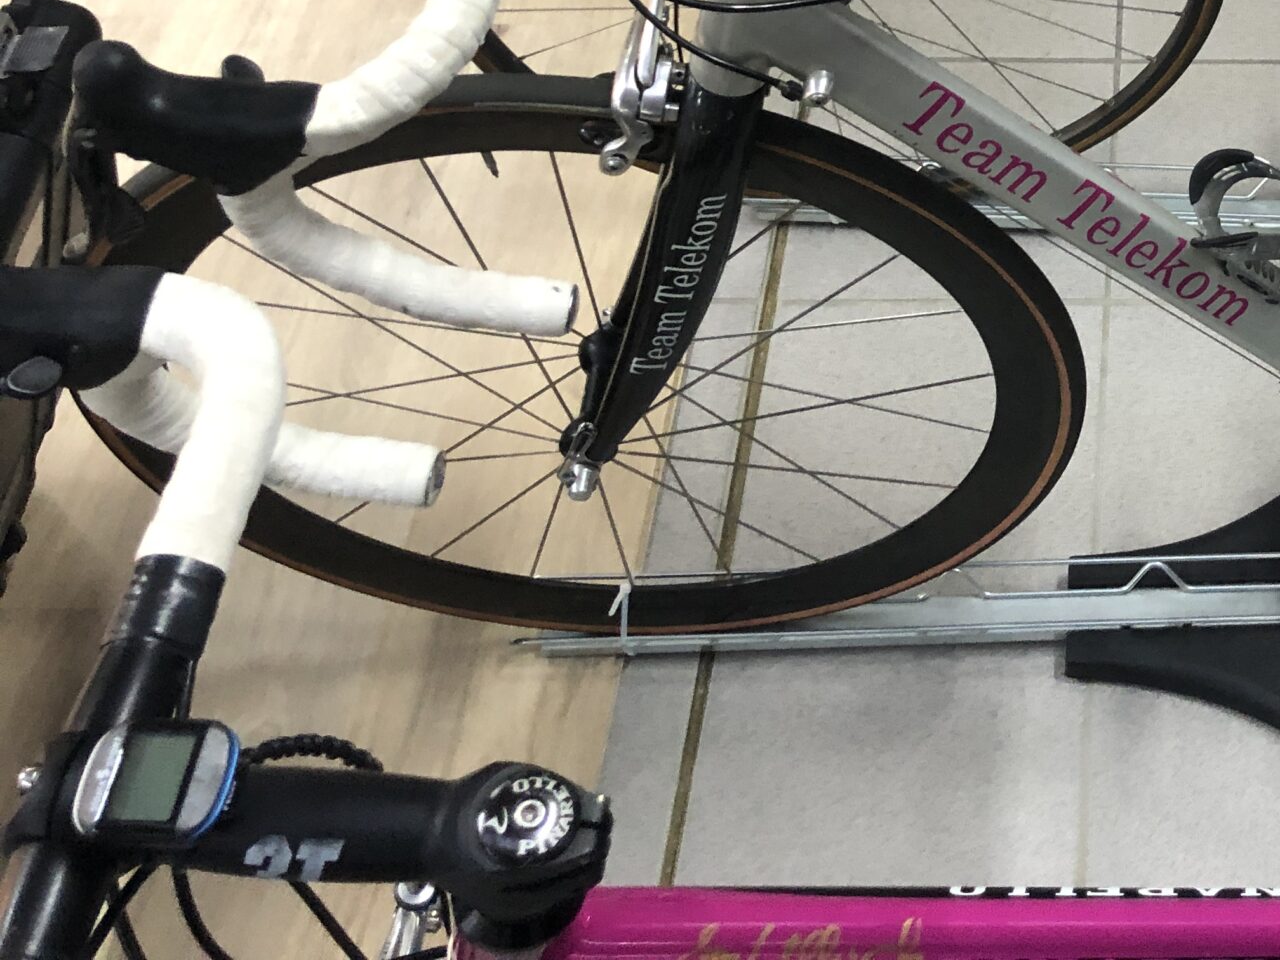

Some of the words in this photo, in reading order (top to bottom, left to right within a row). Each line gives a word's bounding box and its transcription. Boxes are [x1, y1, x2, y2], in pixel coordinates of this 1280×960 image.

[654, 192, 728, 305] Telekom
[902, 80, 1048, 203] Team
[1056, 178, 1250, 327] Telekom
[630, 309, 688, 375] Team
[511, 775, 575, 858] PINARELLO
